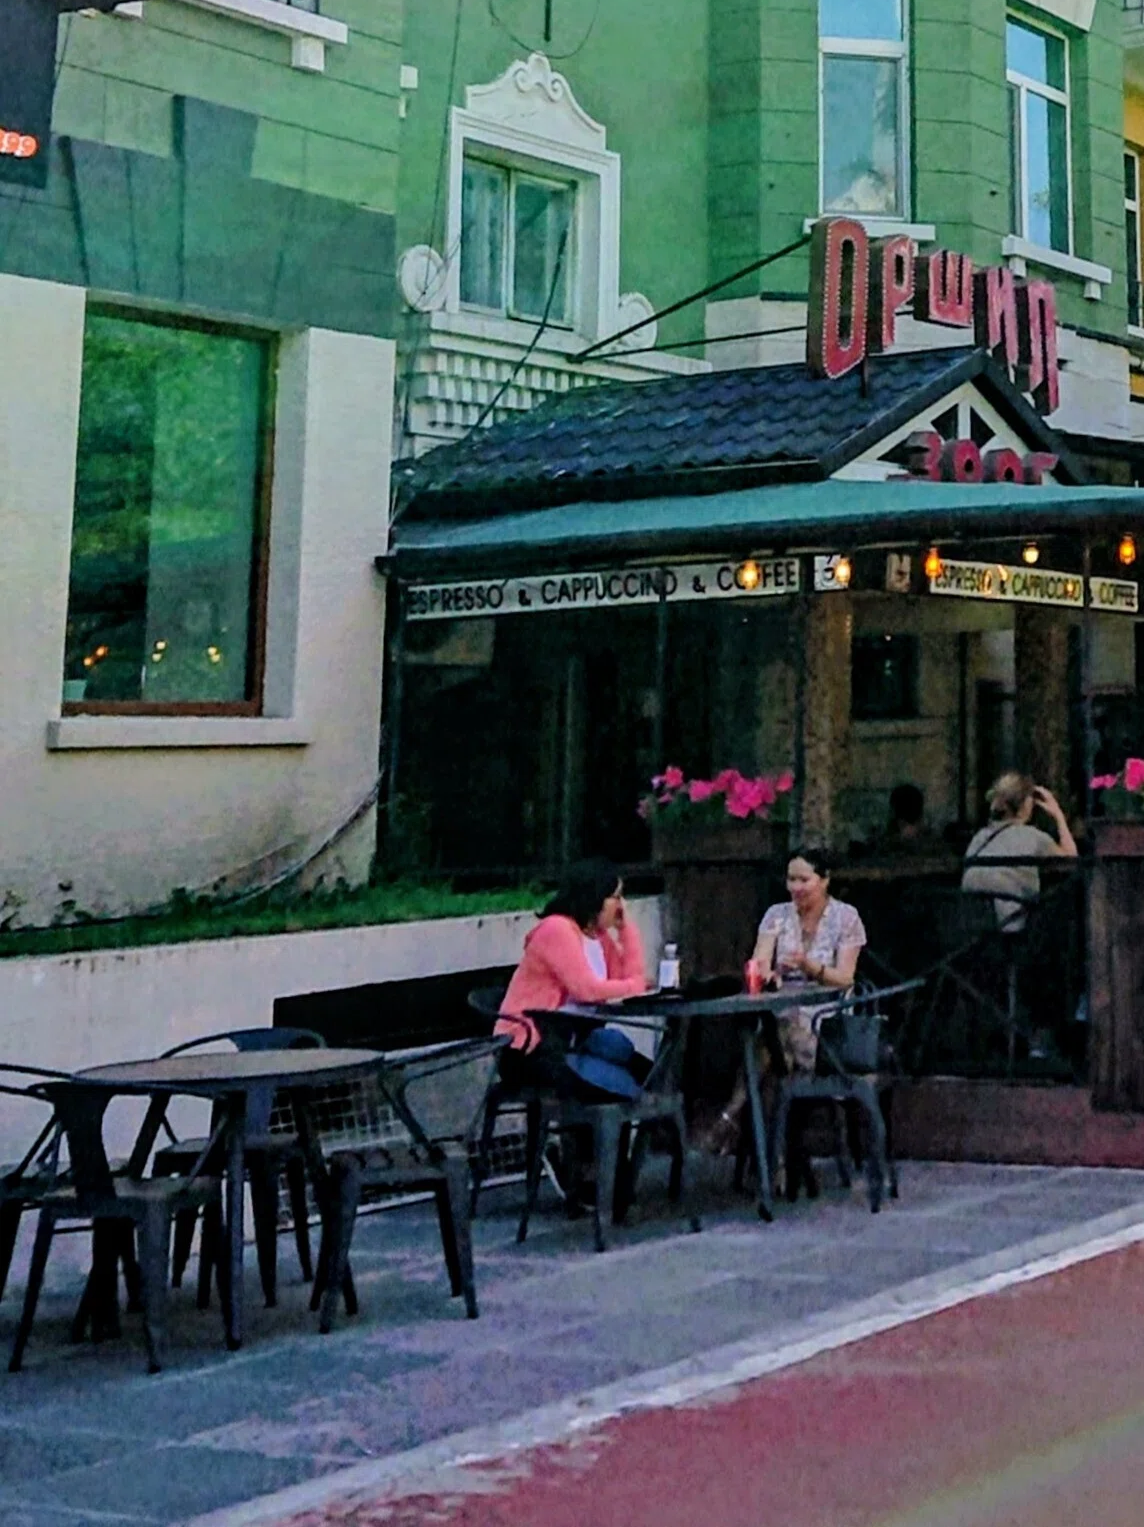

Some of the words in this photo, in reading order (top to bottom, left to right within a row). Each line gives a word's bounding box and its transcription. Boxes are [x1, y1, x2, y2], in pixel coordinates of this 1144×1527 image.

[407, 584, 503, 614] ESPRESSO
[541, 570, 677, 604] CAPPUCCINO
[692, 575, 706, 593] &
[717, 560, 796, 591] COFEE
